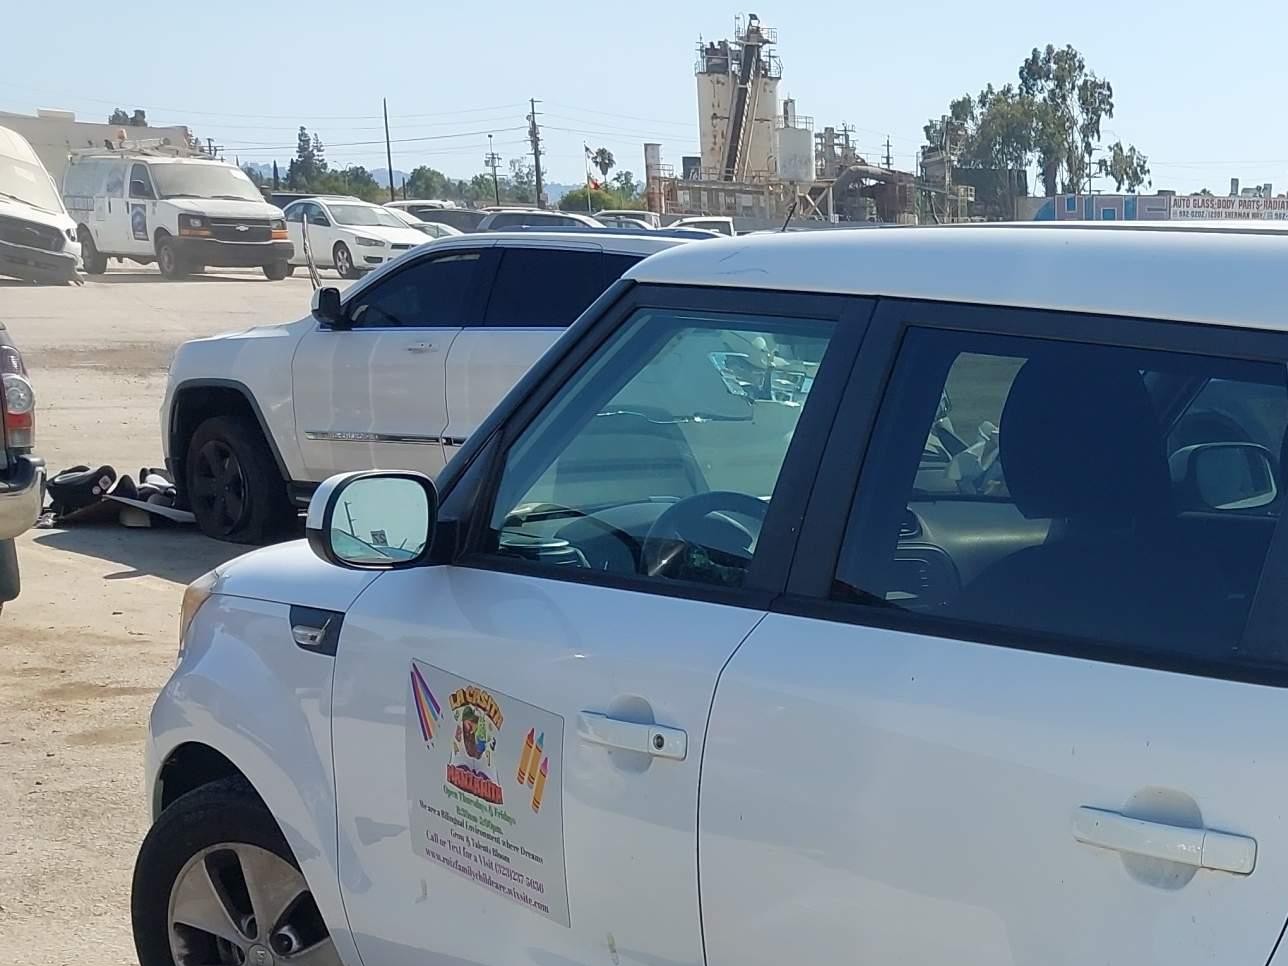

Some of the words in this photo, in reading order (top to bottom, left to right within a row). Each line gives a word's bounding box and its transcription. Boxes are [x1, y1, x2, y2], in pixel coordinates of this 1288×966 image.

[1173, 198, 1191, 209] AUTO
[449, 689, 465, 710] LA
[442, 785, 458, 800] Open
[426, 829, 439, 844] Call
[439, 838, 447, 848] or
[447, 839, 462, 856] Text
[463, 846, 472, 860] for
[441, 809, 465, 828] Bilingual
[465, 821, 501, 845] Environment
[501, 839, 519, 852] where
[520, 846, 544, 864] Dreams
